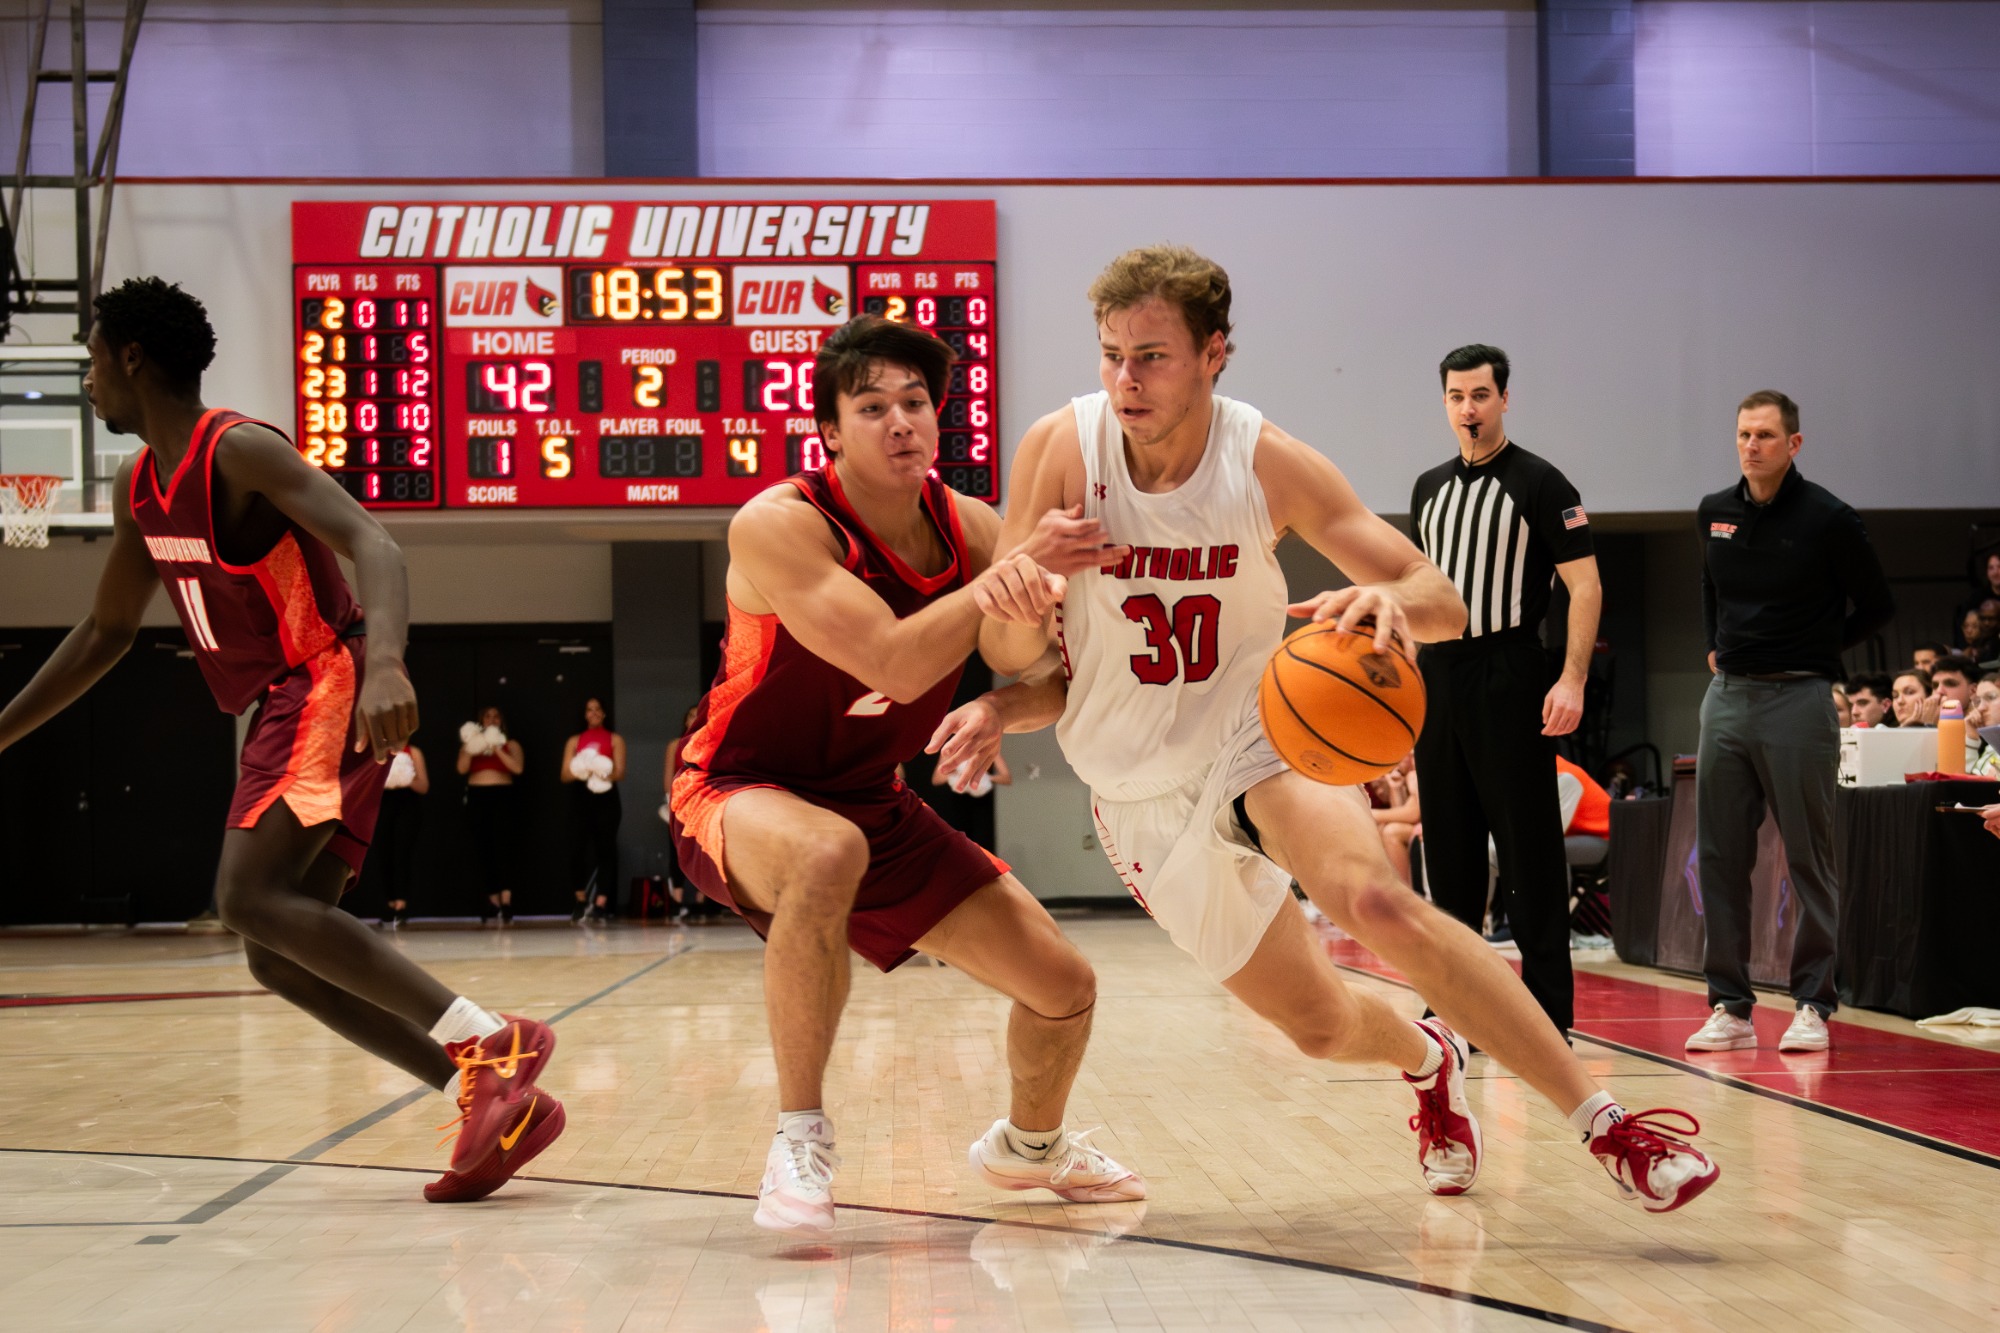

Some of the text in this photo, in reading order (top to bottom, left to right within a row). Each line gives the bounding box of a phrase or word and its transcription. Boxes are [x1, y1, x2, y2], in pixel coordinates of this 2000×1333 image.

[360, 205, 930, 258] CATHOLIC UNIVERSITY
[308, 273, 421, 291] PLYR FLS PTS
[593, 268, 723, 321] 18:53
[869, 272, 980, 289] PLYR FLS PTS
[449, 281, 519, 316] CUA
[737, 280, 805, 315] CUA
[886, 297, 987, 326] 2 0 0
[322, 297, 429, 330] 2 0 11
[302, 332, 346, 364] 21
[408, 334, 430, 363] 5
[471, 331, 555, 355] HOME
[621, 348, 677, 365] PERIOD
[749, 330, 822, 353] GUEST
[968, 333, 987, 357] 4
[302, 367, 347, 399] 23
[400, 369, 430, 397] 12
[483, 361, 552, 412] 42
[634, 365, 664, 408] 2
[969, 365, 988, 393] 8
[305, 402, 430, 433] 30 0 10
[468, 420, 581, 436] FOULS T.O.L.
[599, 419, 705, 436] PLAYER FOUL
[721, 418, 767, 434] T.O.L.
[970, 399, 988, 427] 6
[303, 437, 348, 468] 22
[411, 437, 431, 466] 2
[498, 440, 511, 475] 1
[540, 437, 571, 479] 5
[728, 439, 758, 474] 4
[970, 433, 989, 461] 2
[467, 486, 517, 503] SCORE
[627, 485, 679, 502] MATCH
[177, 577, 220, 651] 11
[1121, 593, 1222, 686] 30
